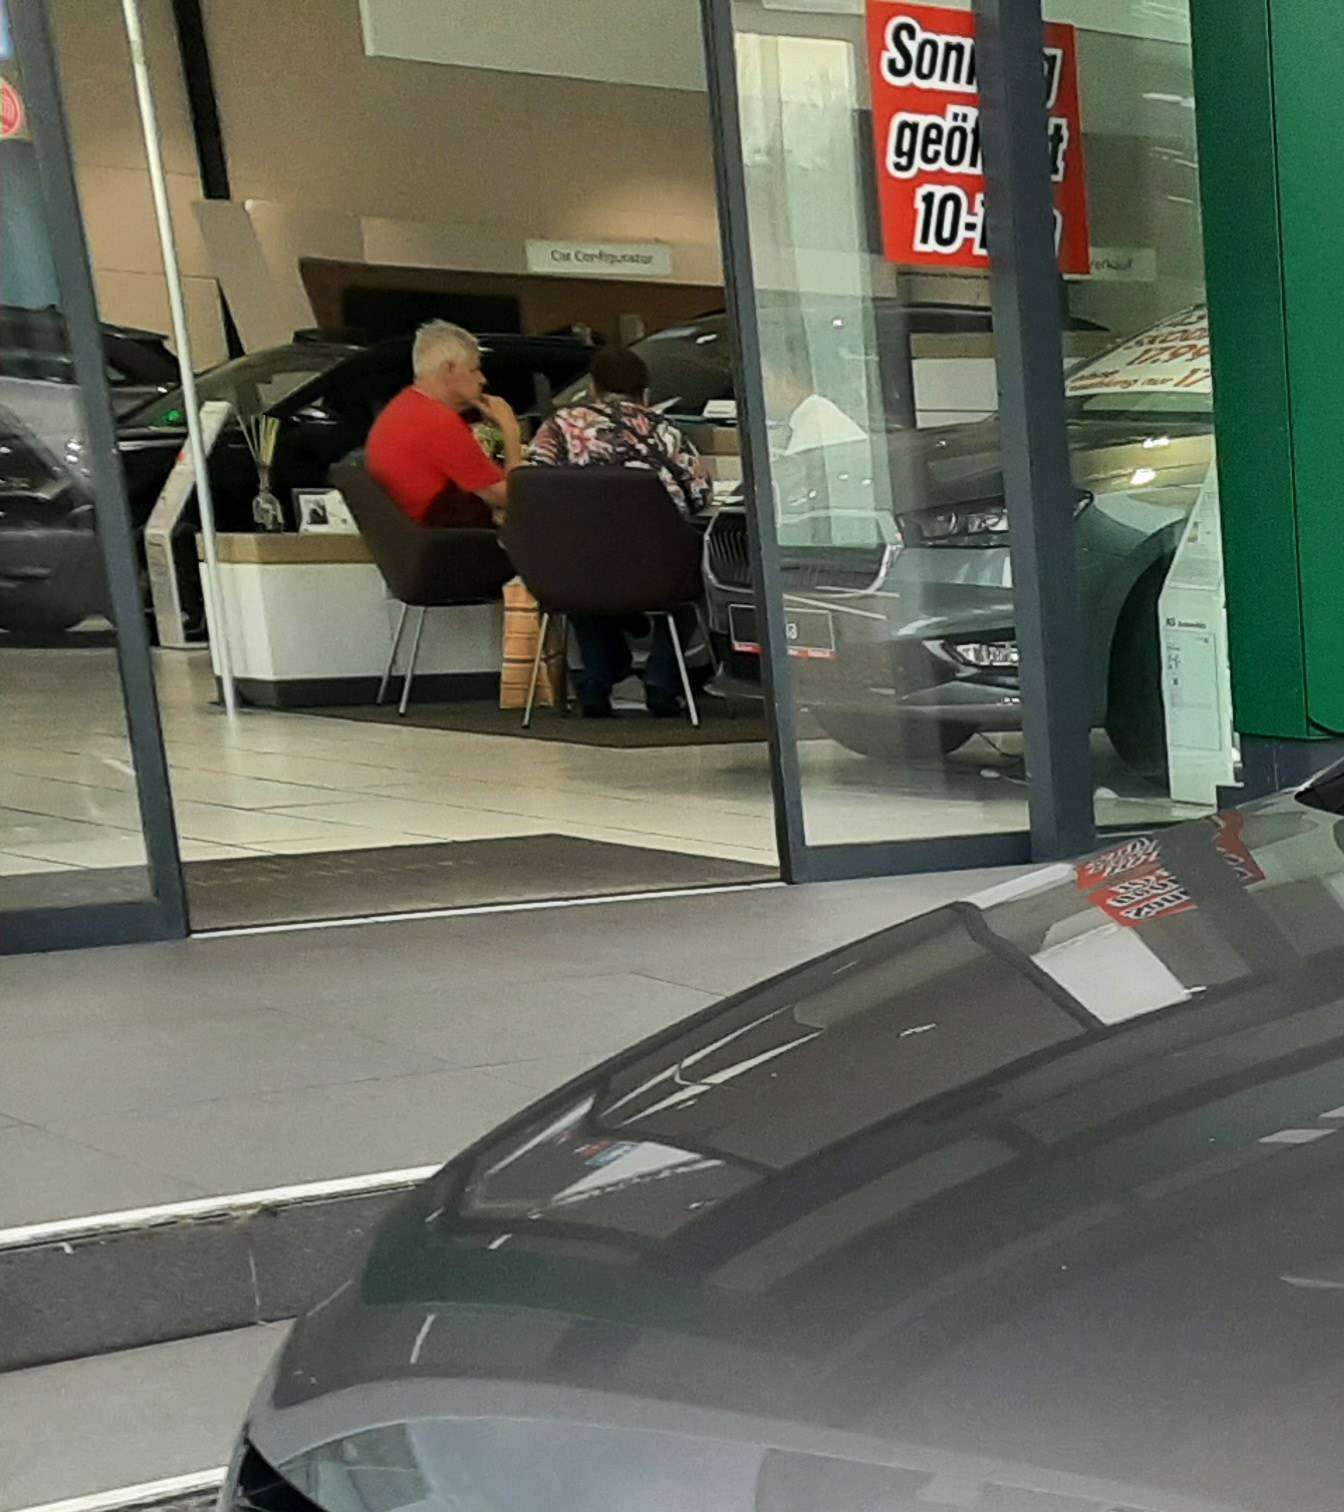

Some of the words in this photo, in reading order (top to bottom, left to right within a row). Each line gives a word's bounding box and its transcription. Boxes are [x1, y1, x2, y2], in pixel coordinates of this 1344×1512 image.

[886, 20, 1058, 108] Song
[892, 112, 1065, 177] geöft
[551, 249, 571, 262] Car
